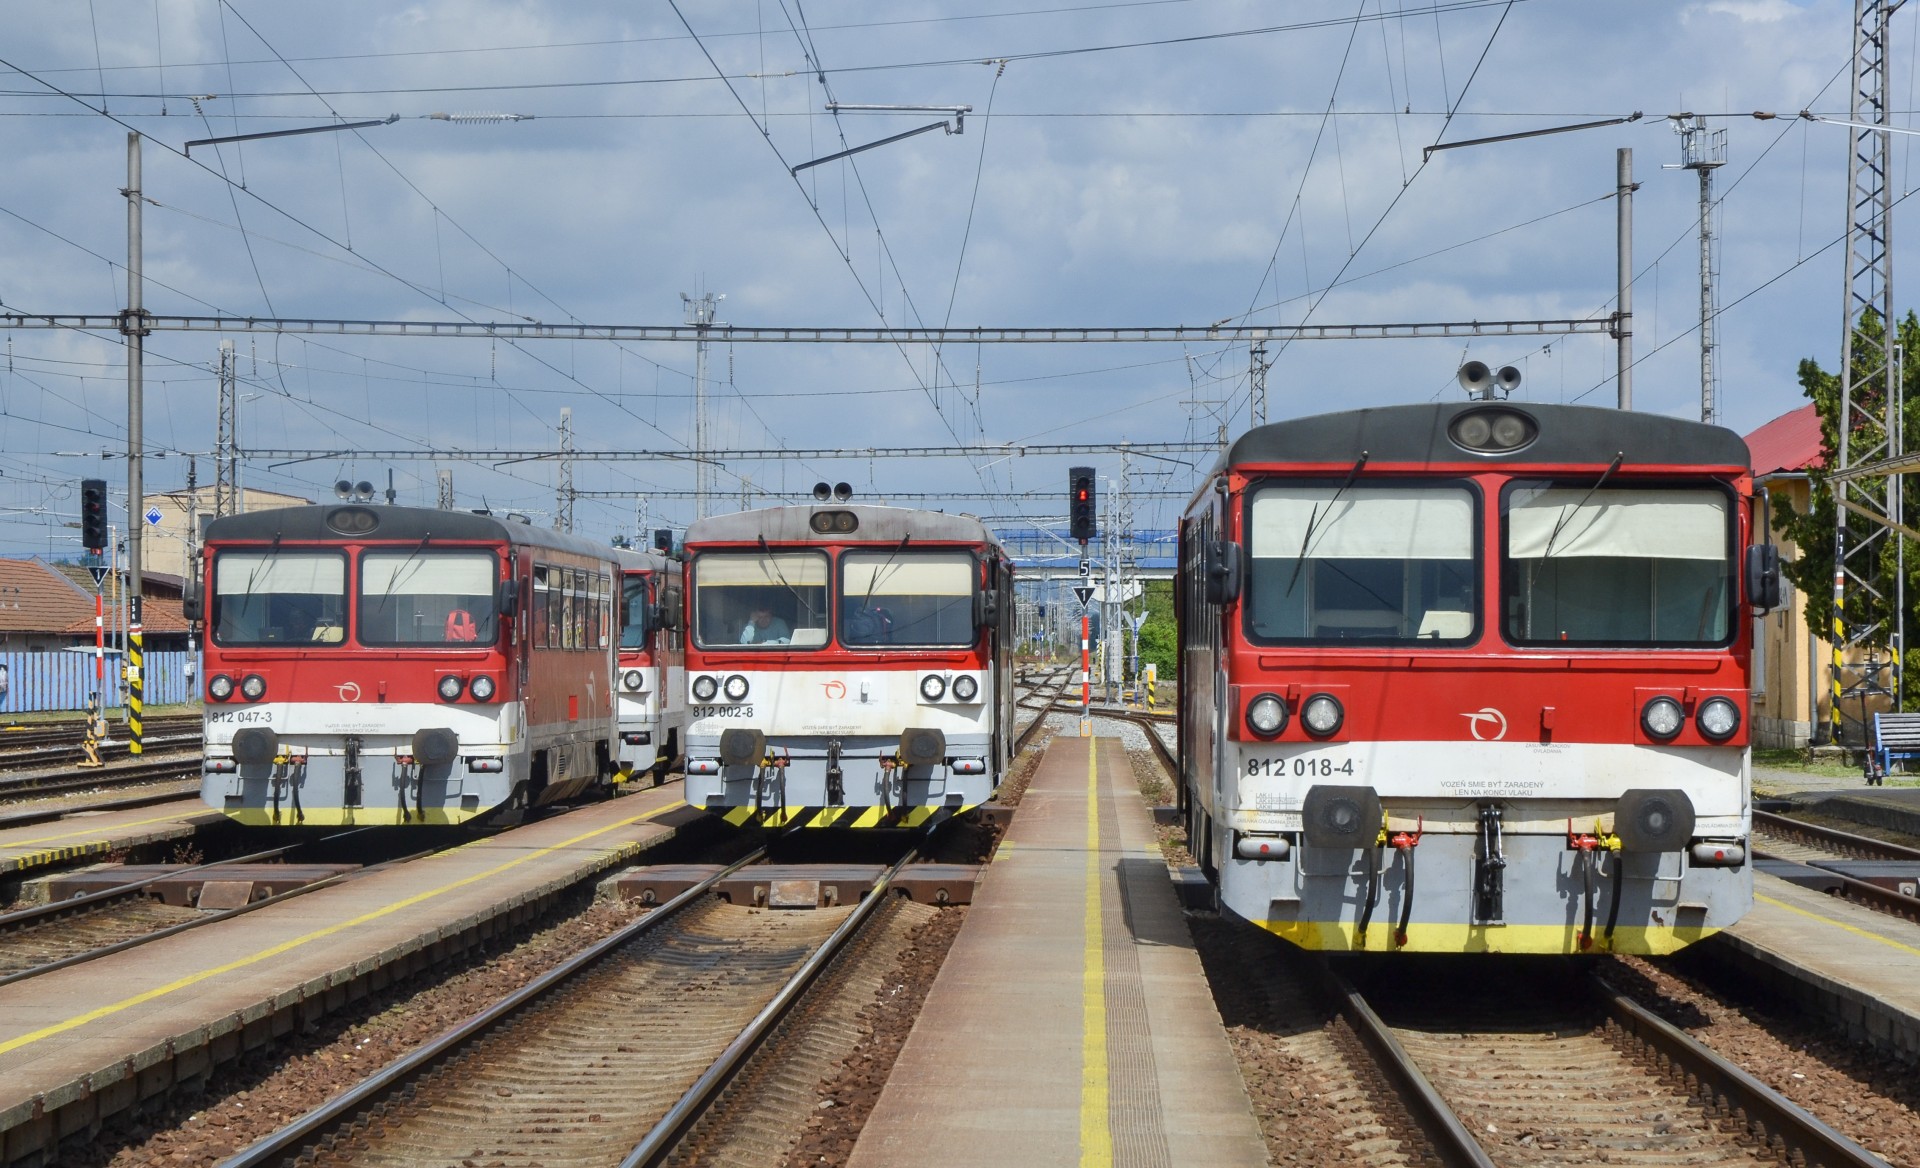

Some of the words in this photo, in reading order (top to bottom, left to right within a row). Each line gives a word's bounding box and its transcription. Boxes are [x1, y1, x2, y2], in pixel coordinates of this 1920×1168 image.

[96, 569, 101, 580] 1
[1080, 561, 1089, 576] 5
[1081, 590, 1086, 602] 1
[212, 711, 234, 723] 812
[237, 711, 272, 723] 047-3
[693, 706, 715, 718] 812
[719, 706, 754, 718] 002-8
[1247, 758, 1286, 777] 812
[1293, 758, 1354, 777] 018-4
[1440, 780, 1466, 788] VOZEŇ
[1487, 780, 1502, 788] BYŤ
[1503, 780, 1545, 789] ZARADENÝ
[1508, 789, 1533, 797] VLAKU
